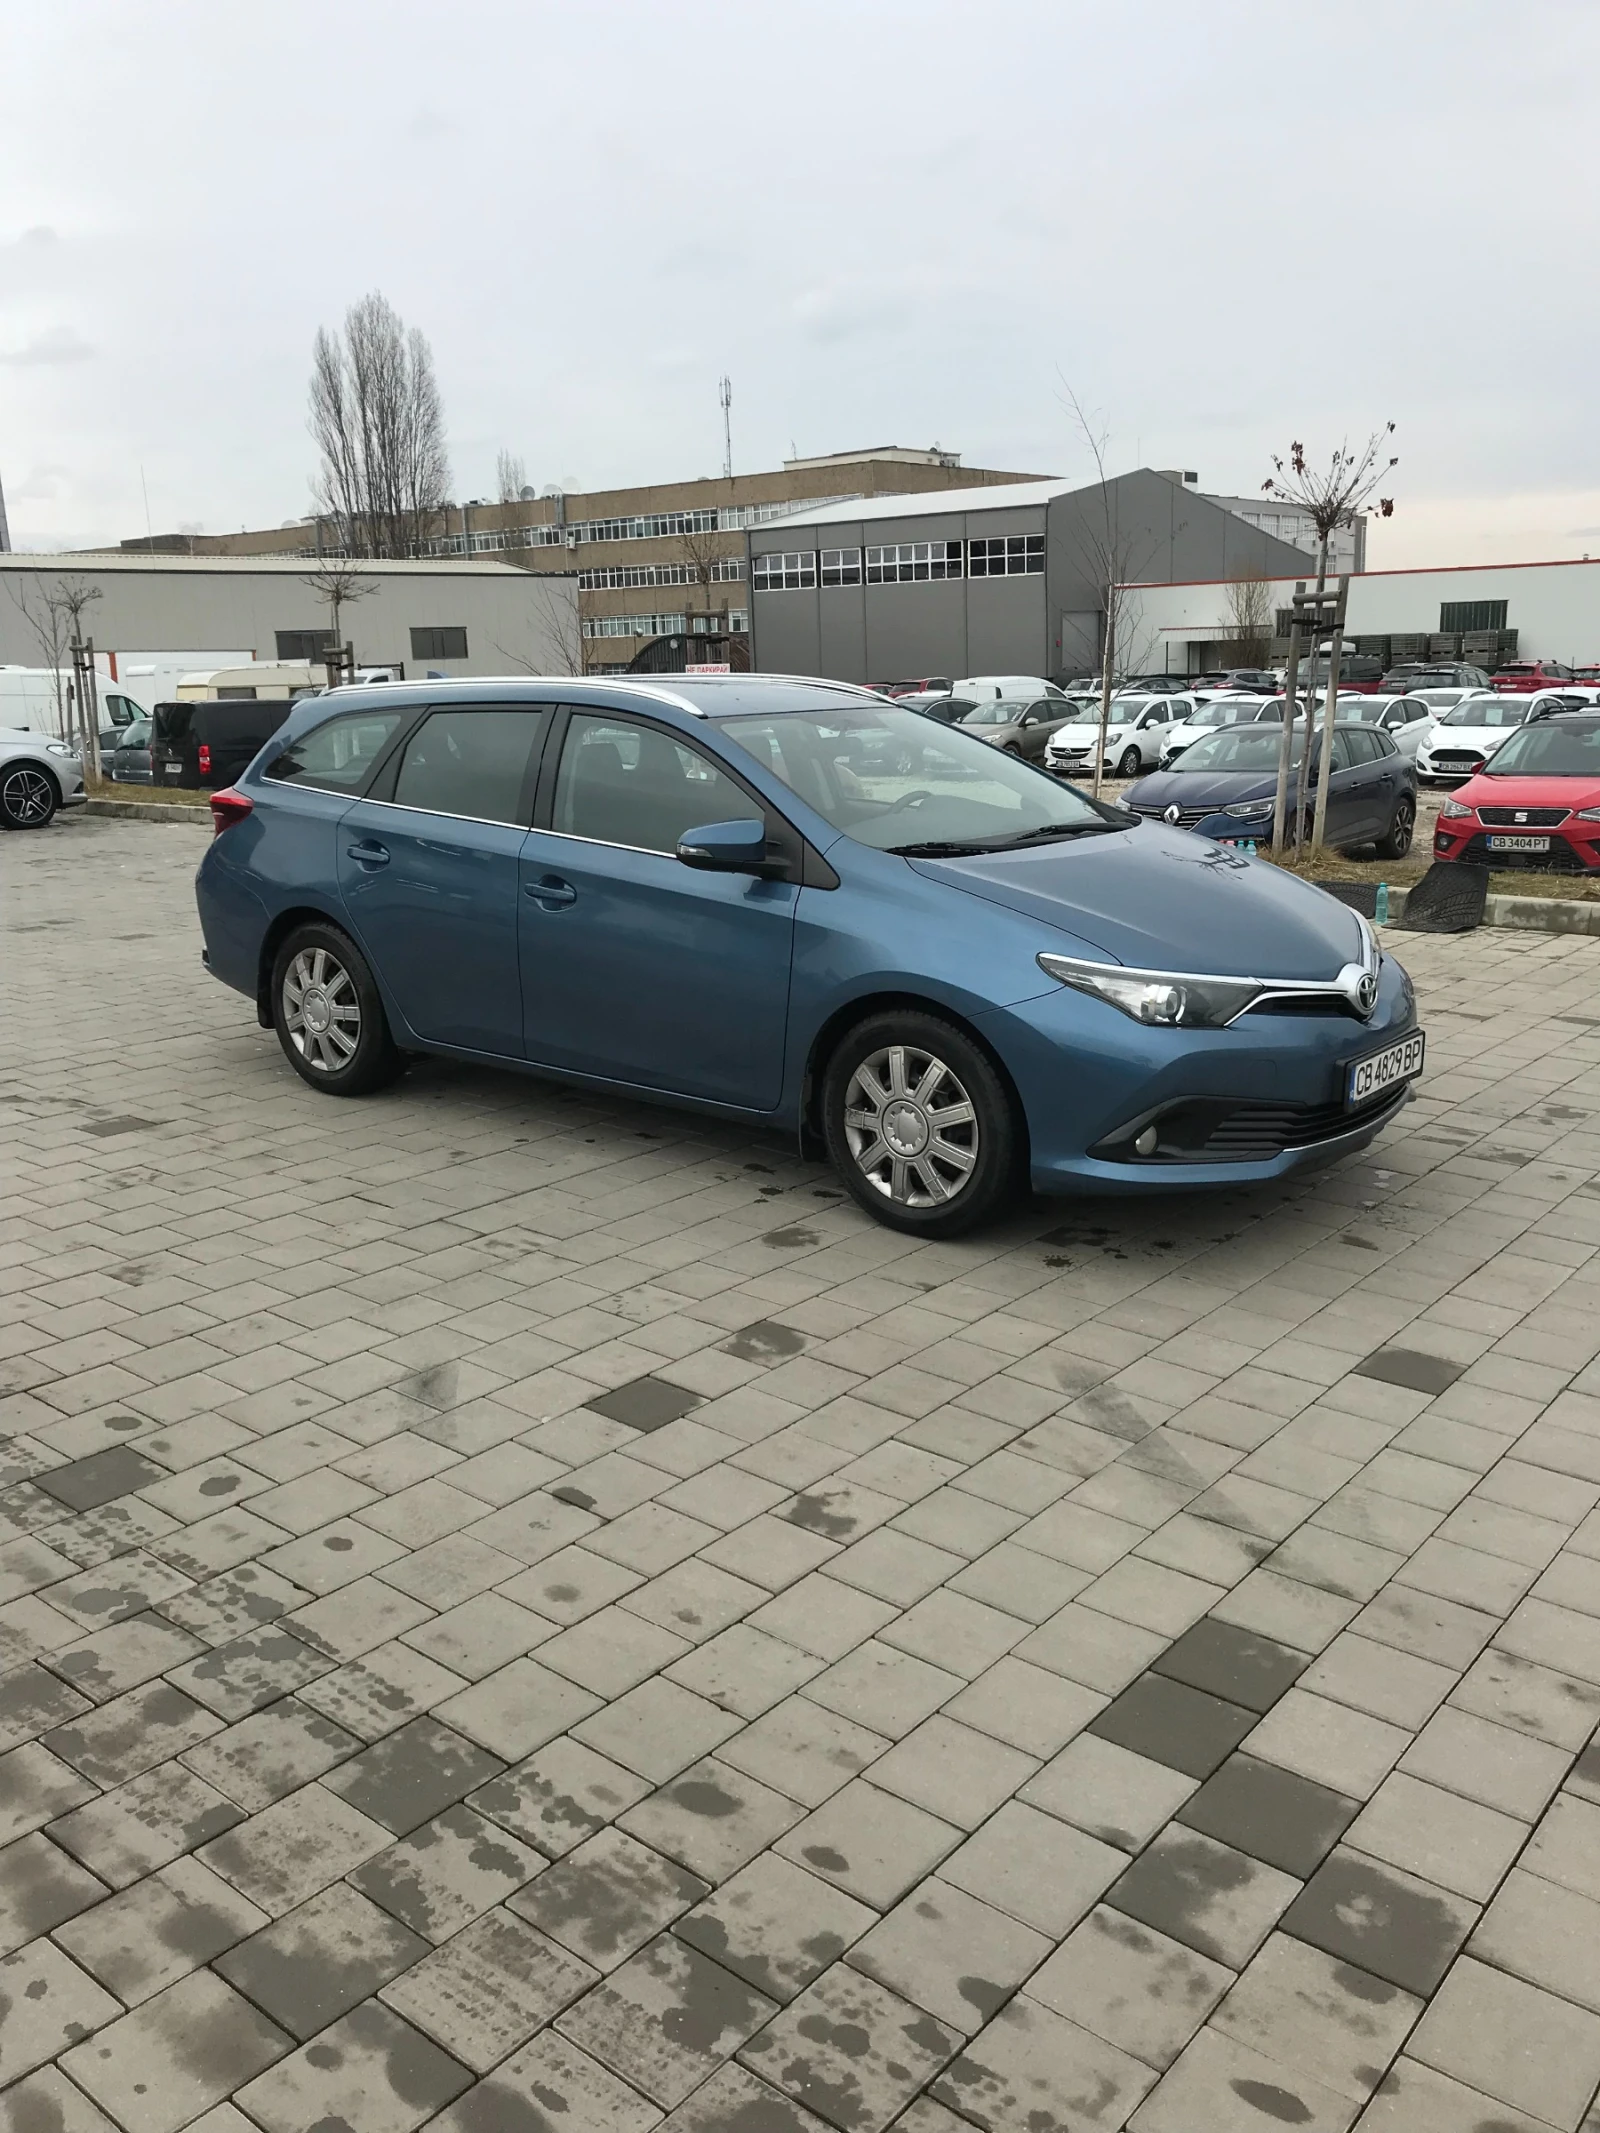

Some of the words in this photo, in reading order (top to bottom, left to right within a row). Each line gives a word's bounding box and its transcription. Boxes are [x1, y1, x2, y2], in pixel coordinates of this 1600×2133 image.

[697, 665, 727, 673] ПАРКИРАЙ
[1493, 837, 1506, 848] CB
[1507, 838, 1532, 848] 3404
[1533, 839, 1548, 849] PT
[1356, 1062, 1373, 1095] CB
[1374, 1047, 1403, 1086] 4829
[1403, 1039, 1421, 1073] BP
